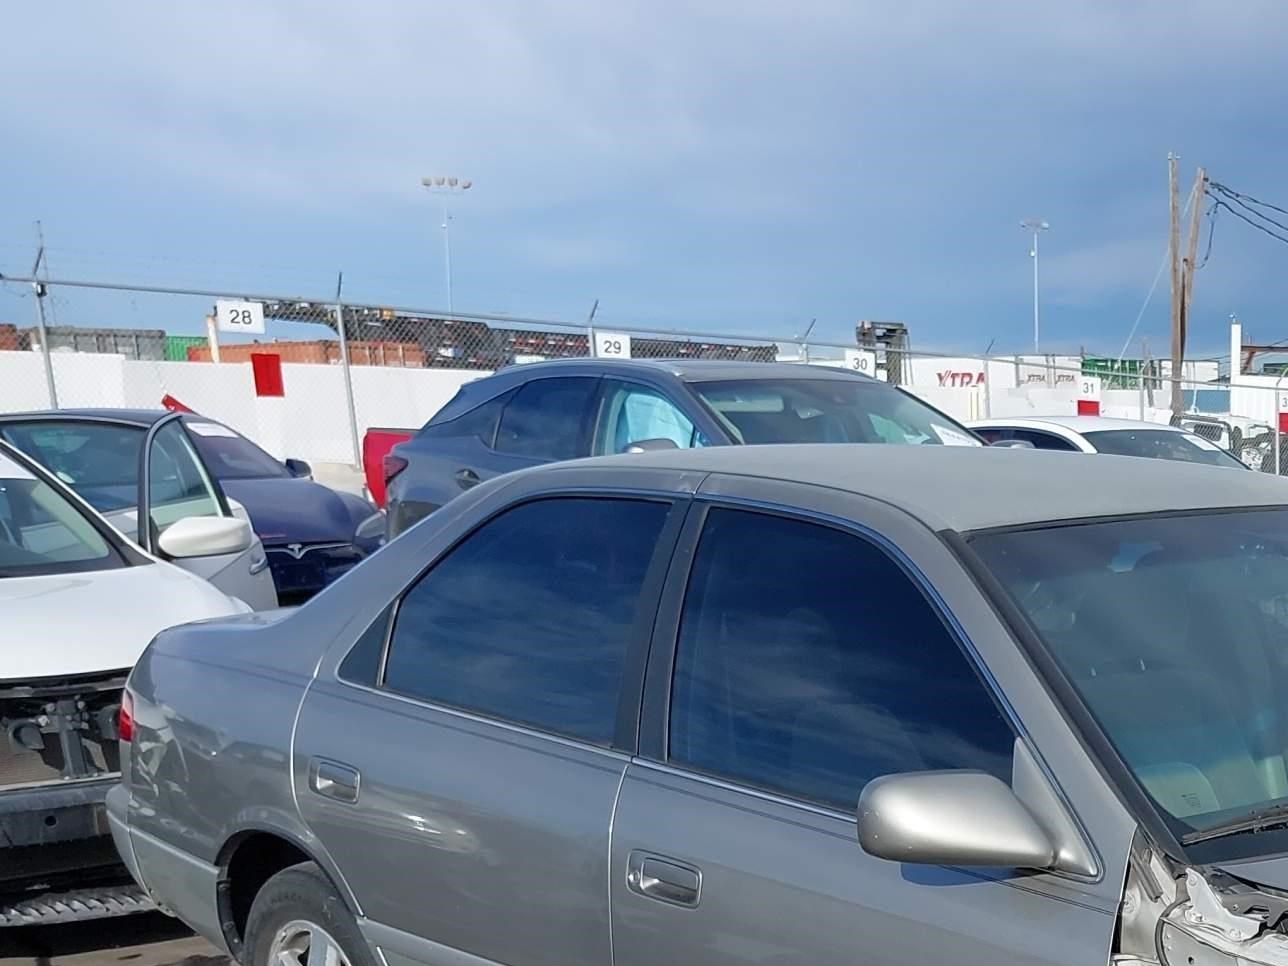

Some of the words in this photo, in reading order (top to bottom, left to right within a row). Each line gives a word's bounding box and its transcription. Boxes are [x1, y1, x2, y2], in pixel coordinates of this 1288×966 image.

[229, 309, 253, 325] 28
[604, 340, 622, 355] 29
[853, 357, 869, 371] 30
[1082, 381, 1095, 394] 31
